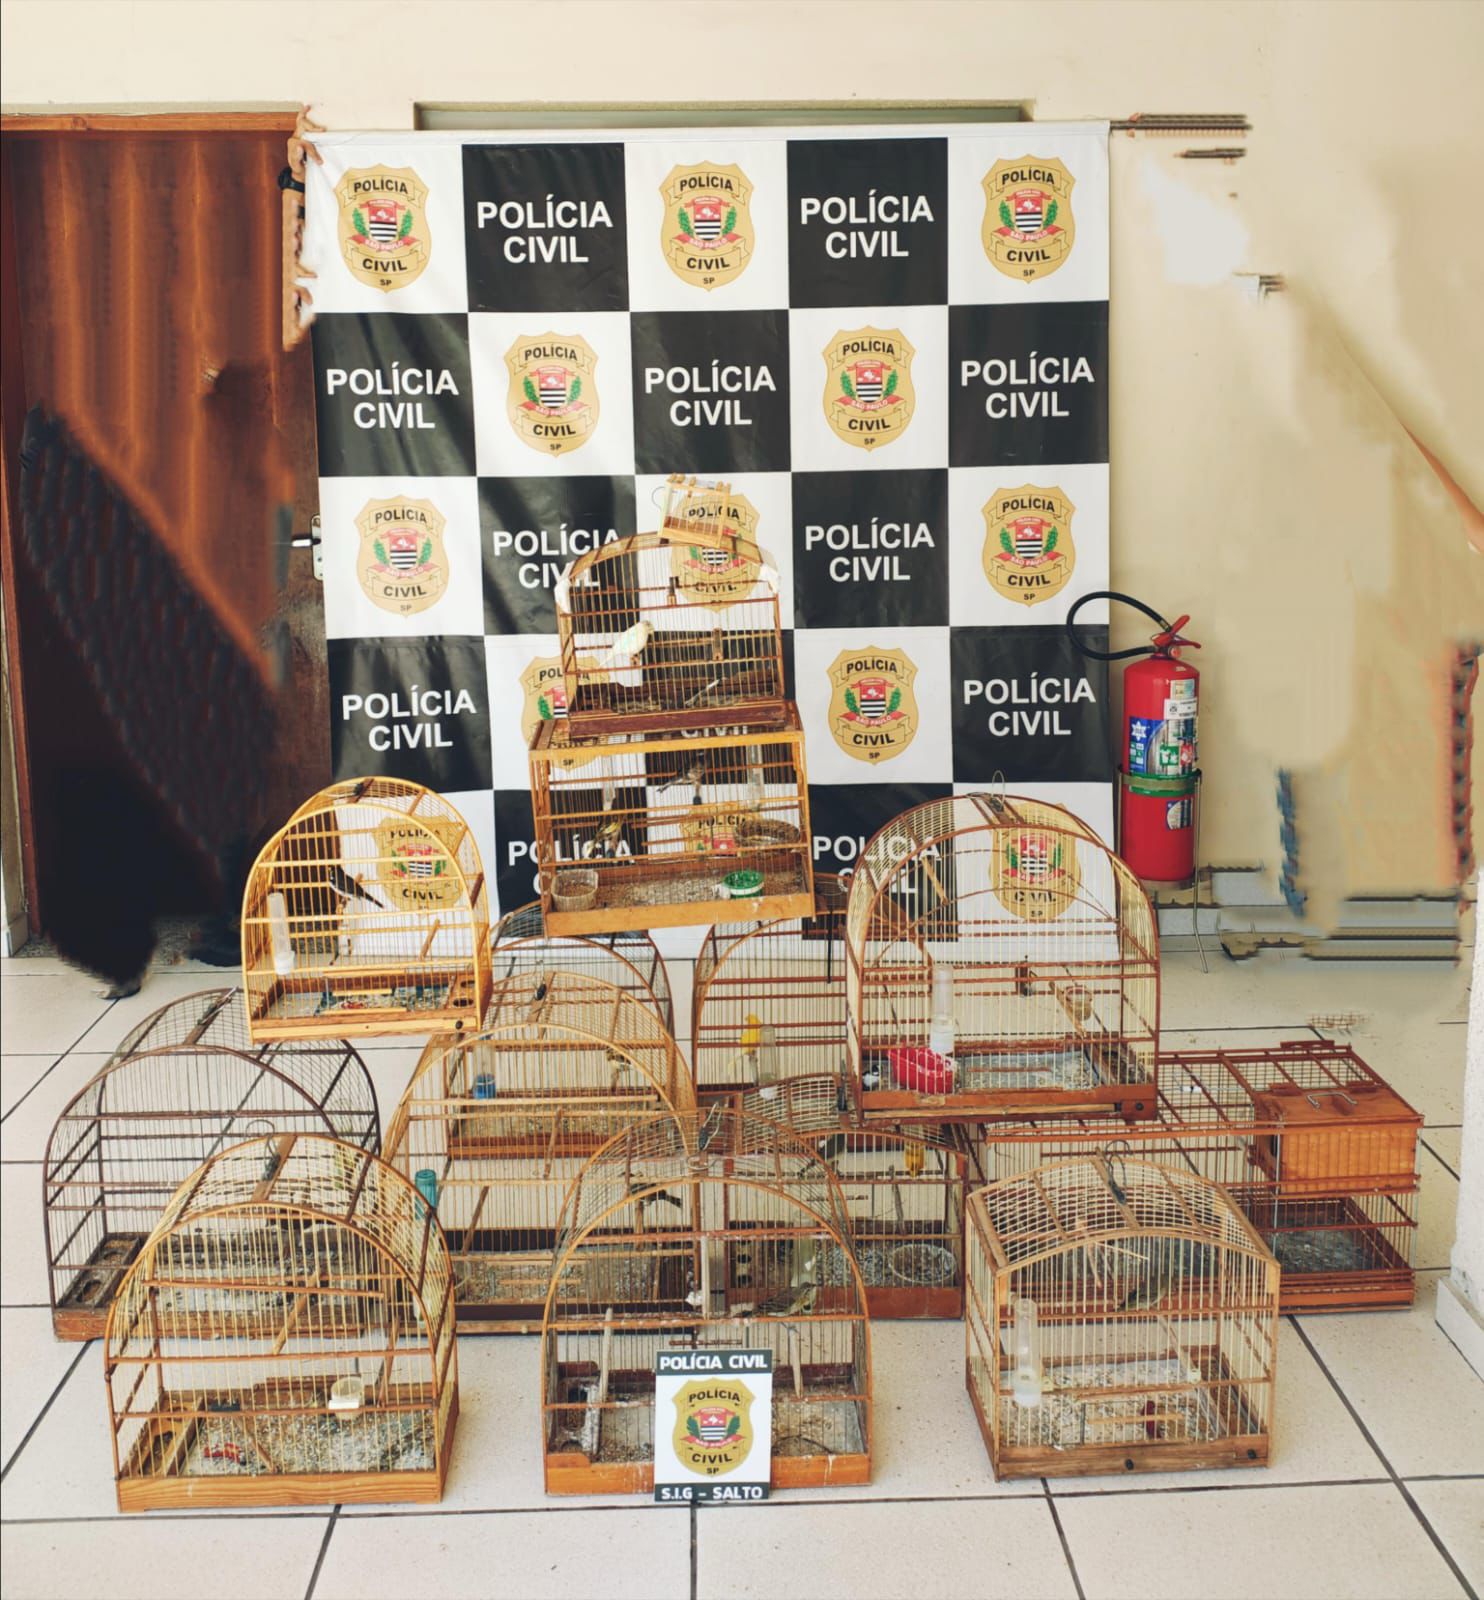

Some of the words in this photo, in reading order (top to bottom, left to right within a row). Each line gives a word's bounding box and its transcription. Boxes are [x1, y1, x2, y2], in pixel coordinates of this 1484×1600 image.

[680, 172, 734, 192] POLÍCIA
[1002, 165, 1055, 185] POLÍCIA
[354, 176, 408, 194] POLÍCIA
[478, 194, 612, 228] POLÍCIA
[801, 190, 933, 224] POLÍCIA
[504, 236, 588, 263] CIVIL
[826, 231, 908, 258] CIVIL
[686, 257, 730, 270] CIVIL
[1006, 249, 1050, 262] CIVIL
[362, 258, 408, 272] CIVIL
[1023, 269, 1035, 277] SP
[524, 343, 578, 361] POLÍCIA
[842, 337, 895, 356] POLÍCIA
[645, 360, 776, 393] POLÍCIA
[962, 352, 1094, 386] POLÍCIA
[327, 362, 459, 395] POLÍCIA
[670, 400, 752, 426] CIVIL
[986, 392, 1068, 418] CIVIL
[354, 402, 435, 428] CIVIL
[533, 424, 576, 437] CIVIL
[848, 418, 891, 431] CIVIL
[1002, 494, 1055, 512] POLÍCIA
[375, 506, 428, 524] POLÍCIA
[806, 518, 934, 550] POLÍCIA
[830, 556, 910, 581] CIVIL
[1008, 574, 1050, 586] CIVIL
[384, 585, 427, 597] CIVIL
[400, 604, 412, 612] SP
[846, 657, 897, 674] POLÍCIA
[964, 673, 1096, 704] POLÍCIA
[343, 684, 476, 720] POLÍCIA
[989, 711, 1070, 736] CIVIL
[369, 724, 452, 751] CIVIL
[853, 734, 895, 746] CIVIL
[869, 752, 880, 760] SP
[660, 1353, 722, 1370] POLÍCIA
[728, 1355, 768, 1369] CIVIL
[688, 1388, 740, 1402] POLÍCIA
[692, 1453, 732, 1464] CIVIL
[661, 1487, 692, 1500] S.I.G
[712, 1486, 762, 1499] SALTO
